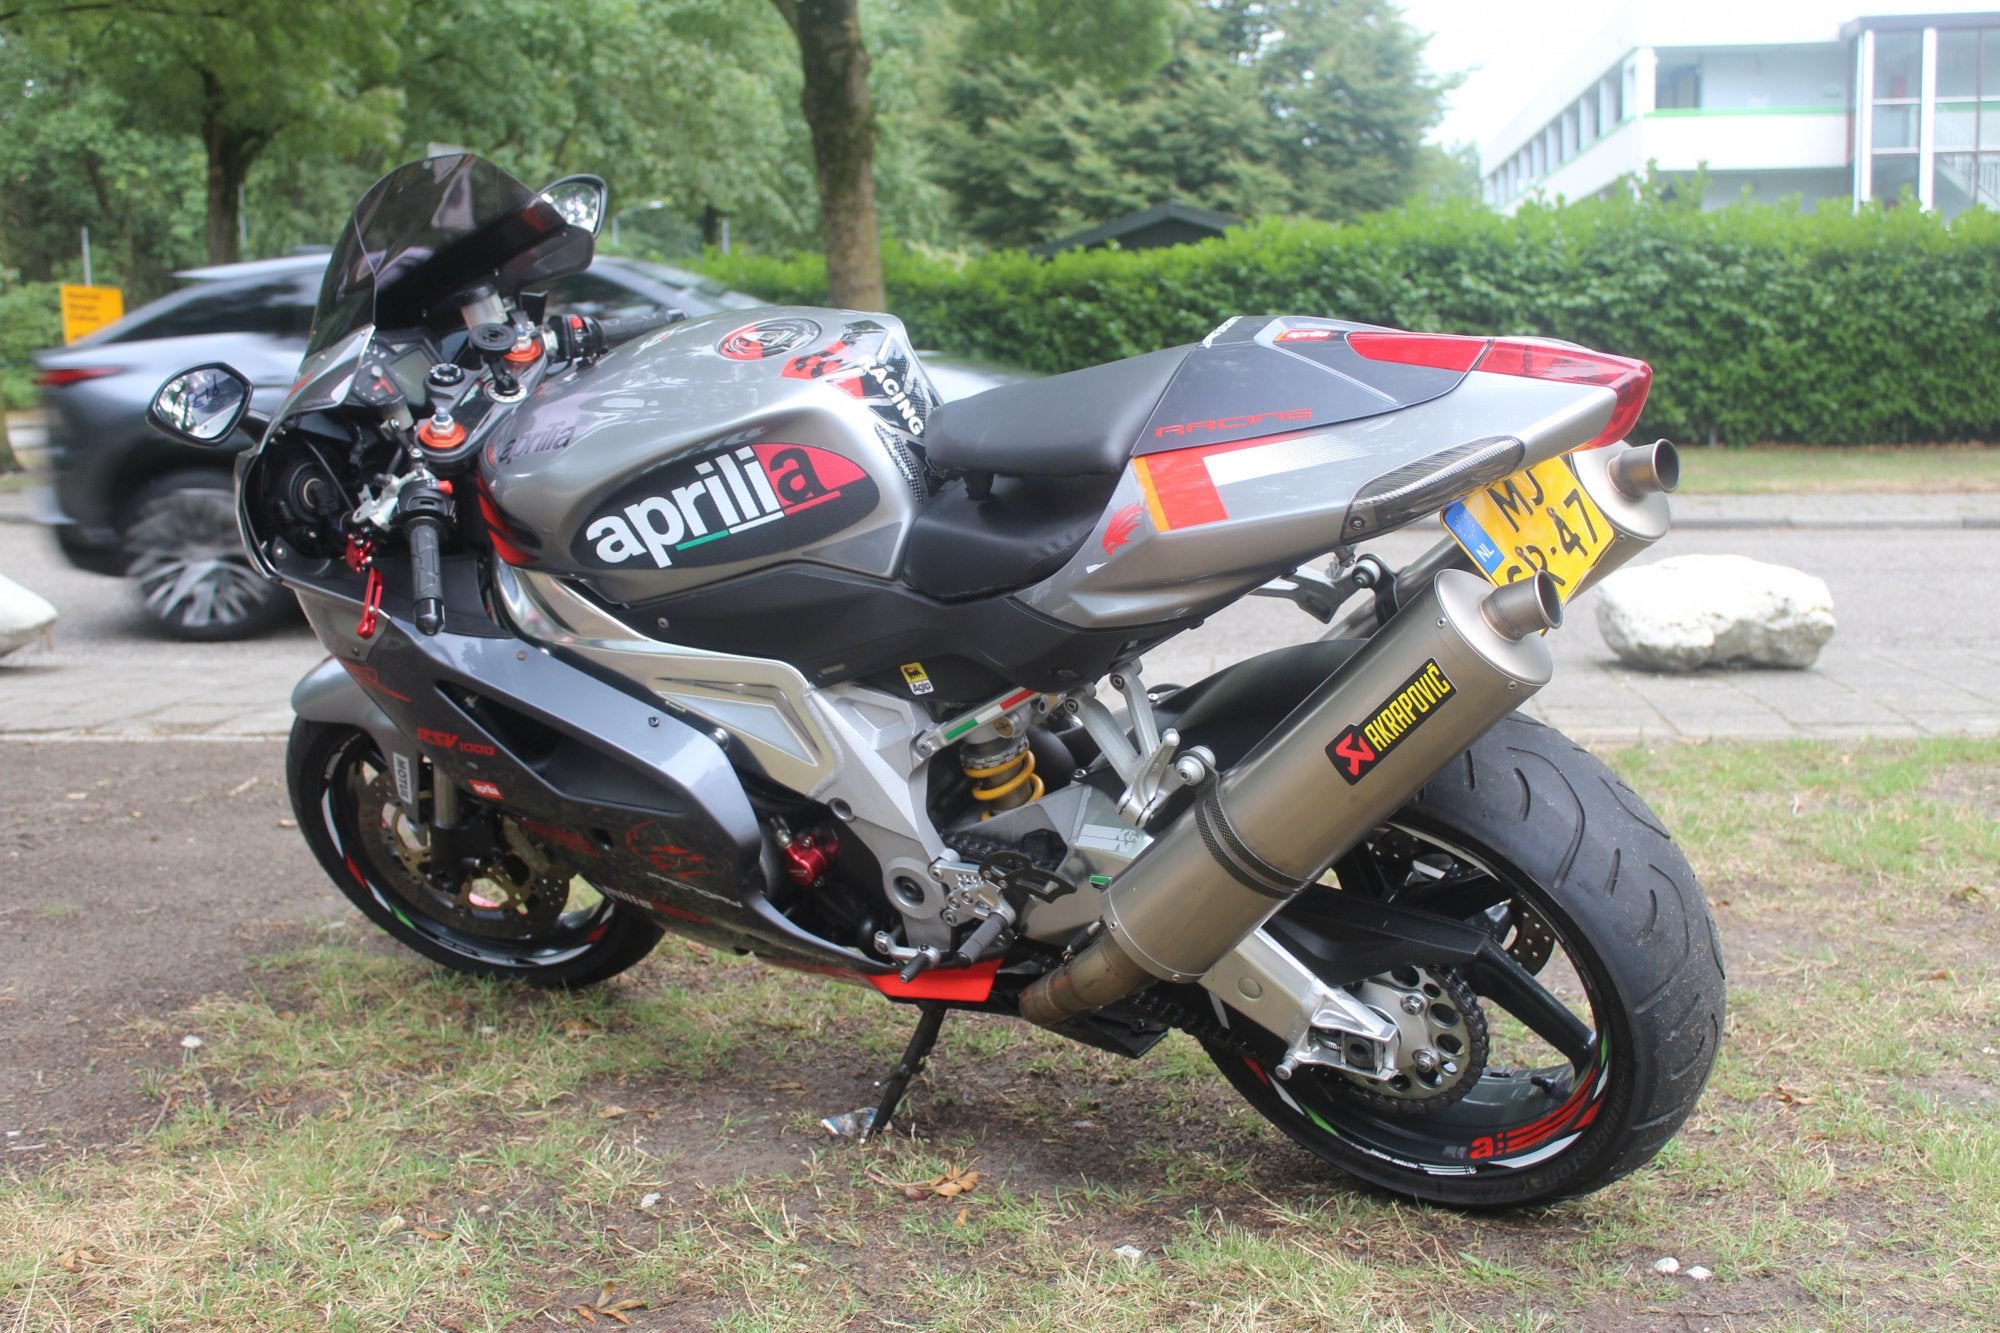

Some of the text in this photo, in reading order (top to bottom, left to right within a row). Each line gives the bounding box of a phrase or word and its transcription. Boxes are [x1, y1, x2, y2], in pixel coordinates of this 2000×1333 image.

[860, 354, 925, 436] RACING
[1155, 408, 1313, 438] RACING
[586, 446, 827, 568] aprilia
[1475, 542, 1495, 563] NL
[912, 682, 932, 693] Agip
[416, 727, 496, 756] RSV 1000
